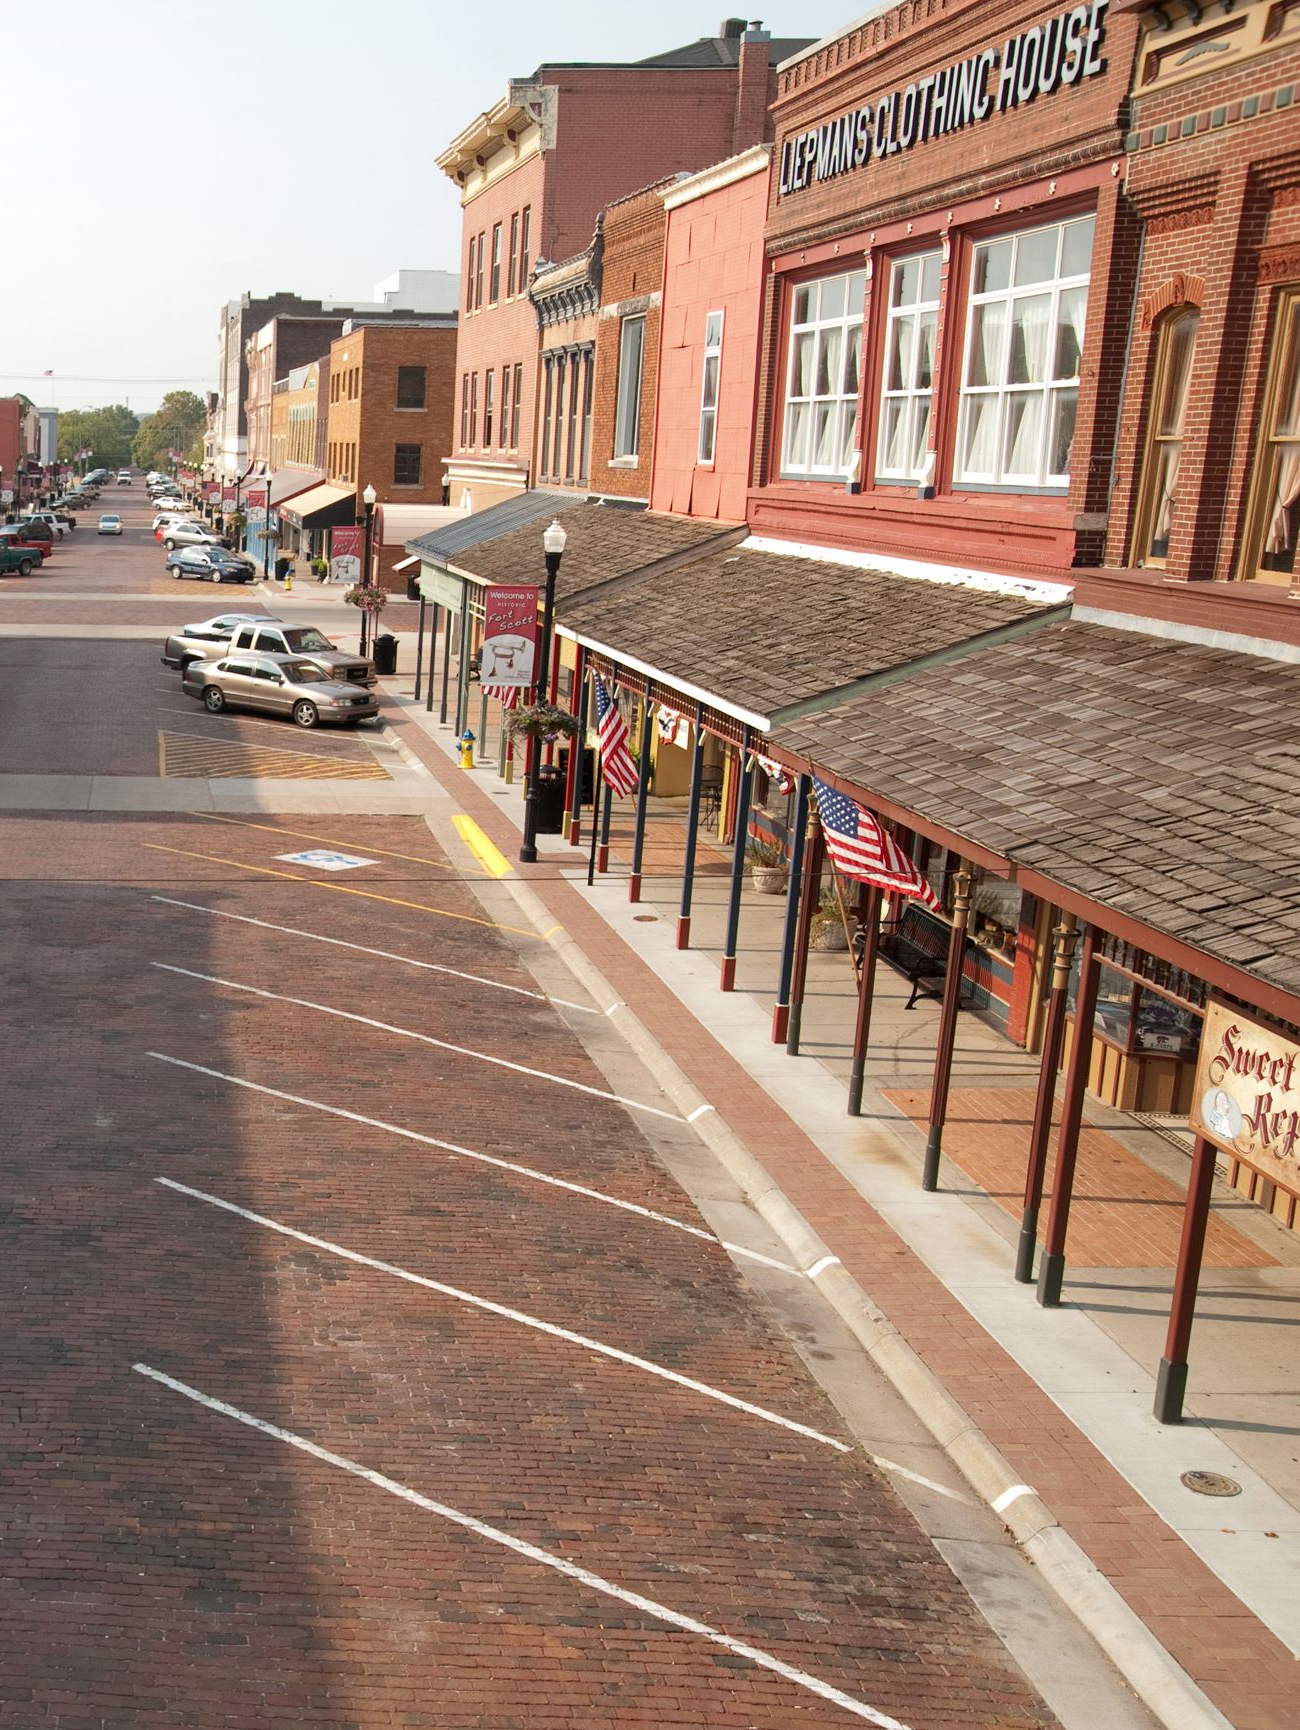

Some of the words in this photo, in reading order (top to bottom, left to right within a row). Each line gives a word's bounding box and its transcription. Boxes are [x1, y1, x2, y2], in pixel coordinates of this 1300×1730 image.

[779, 105, 874, 195] LIEPMANS
[873, 48, 999, 158] CLOTHING
[997, 0, 1110, 112] HOUSE
[490, 591, 525, 600] Welcome
[488, 609, 513, 624] Fort
[499, 615, 533, 631] Scott
[1209, 1024, 1300, 1092] Sweet
